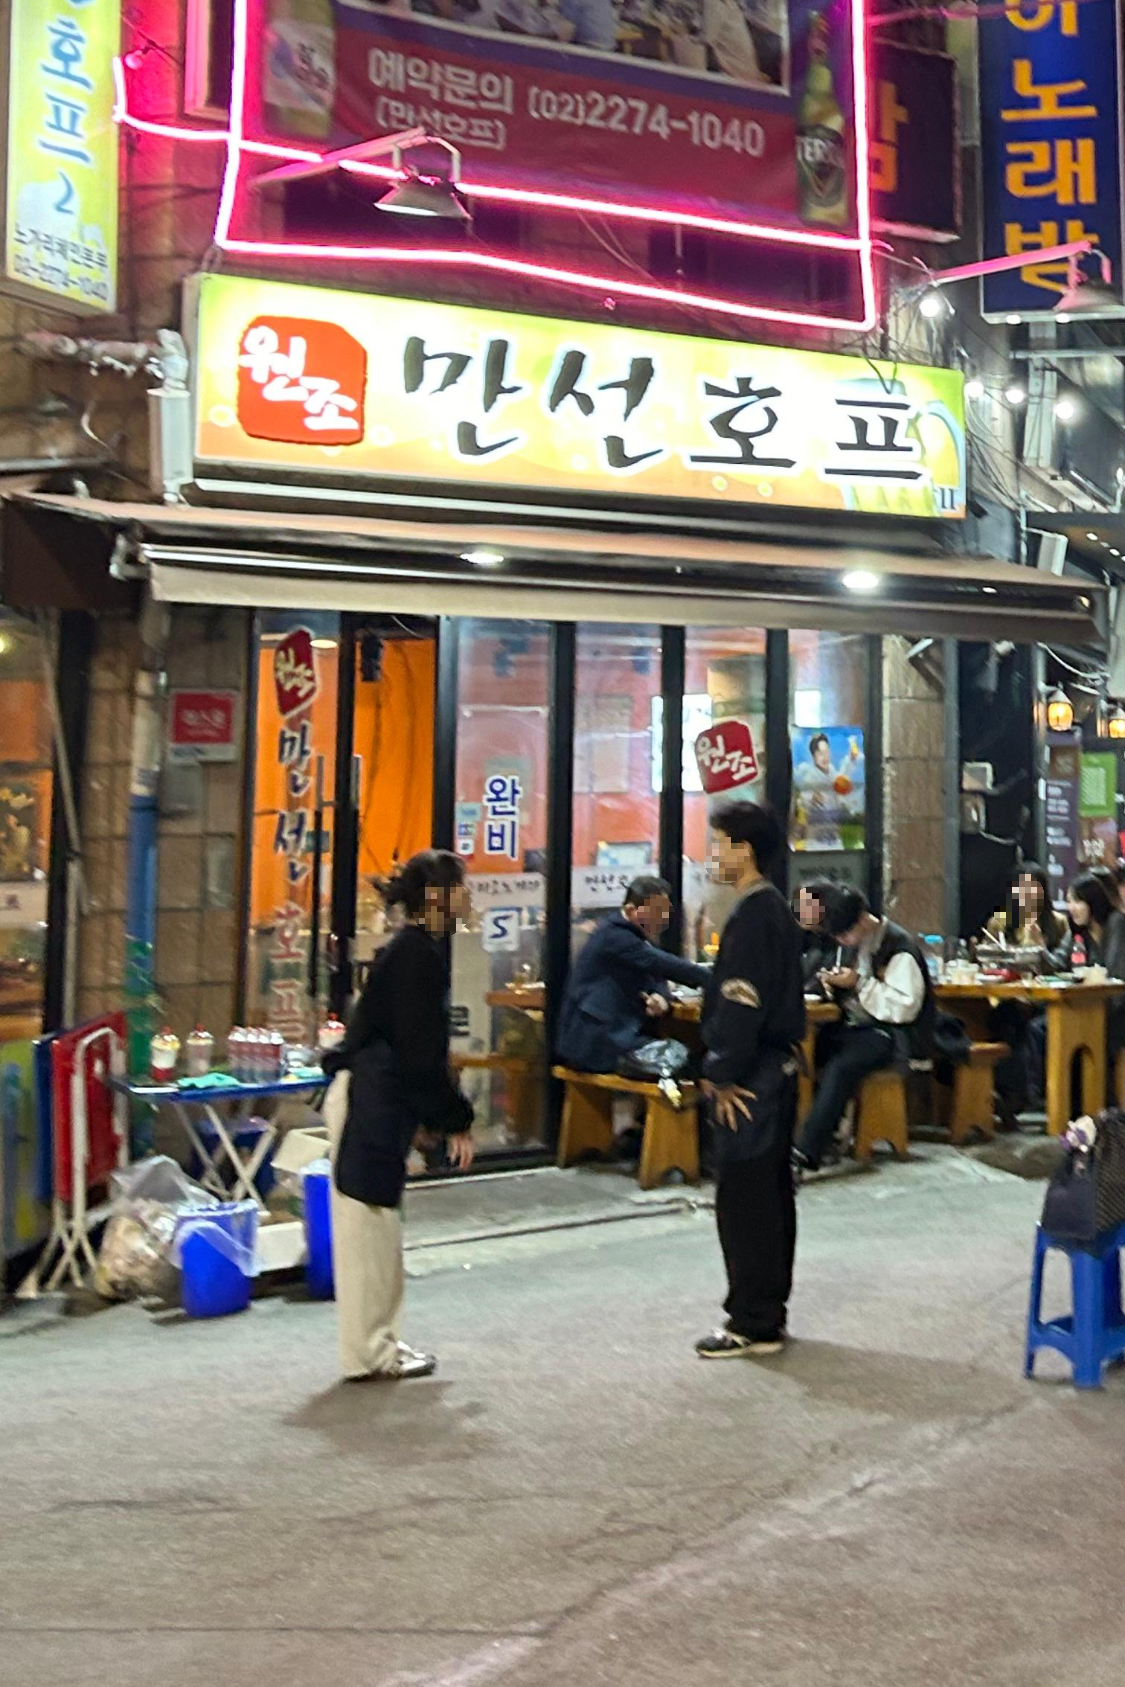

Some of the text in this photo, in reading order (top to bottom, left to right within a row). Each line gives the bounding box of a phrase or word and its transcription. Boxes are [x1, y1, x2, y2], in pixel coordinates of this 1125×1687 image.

[38, 0, 94, 164] 호프
[366, 46, 514, 115] 예약문의
[527, 84, 767, 159] (02)2274-1040
[237, 324, 360, 432] 원조
[403, 334, 923, 482] 만선호프
[697, 734, 757, 781] 원조
[486, 776, 521, 859] 완비
[272, 722, 312, 1037] 만선호프
